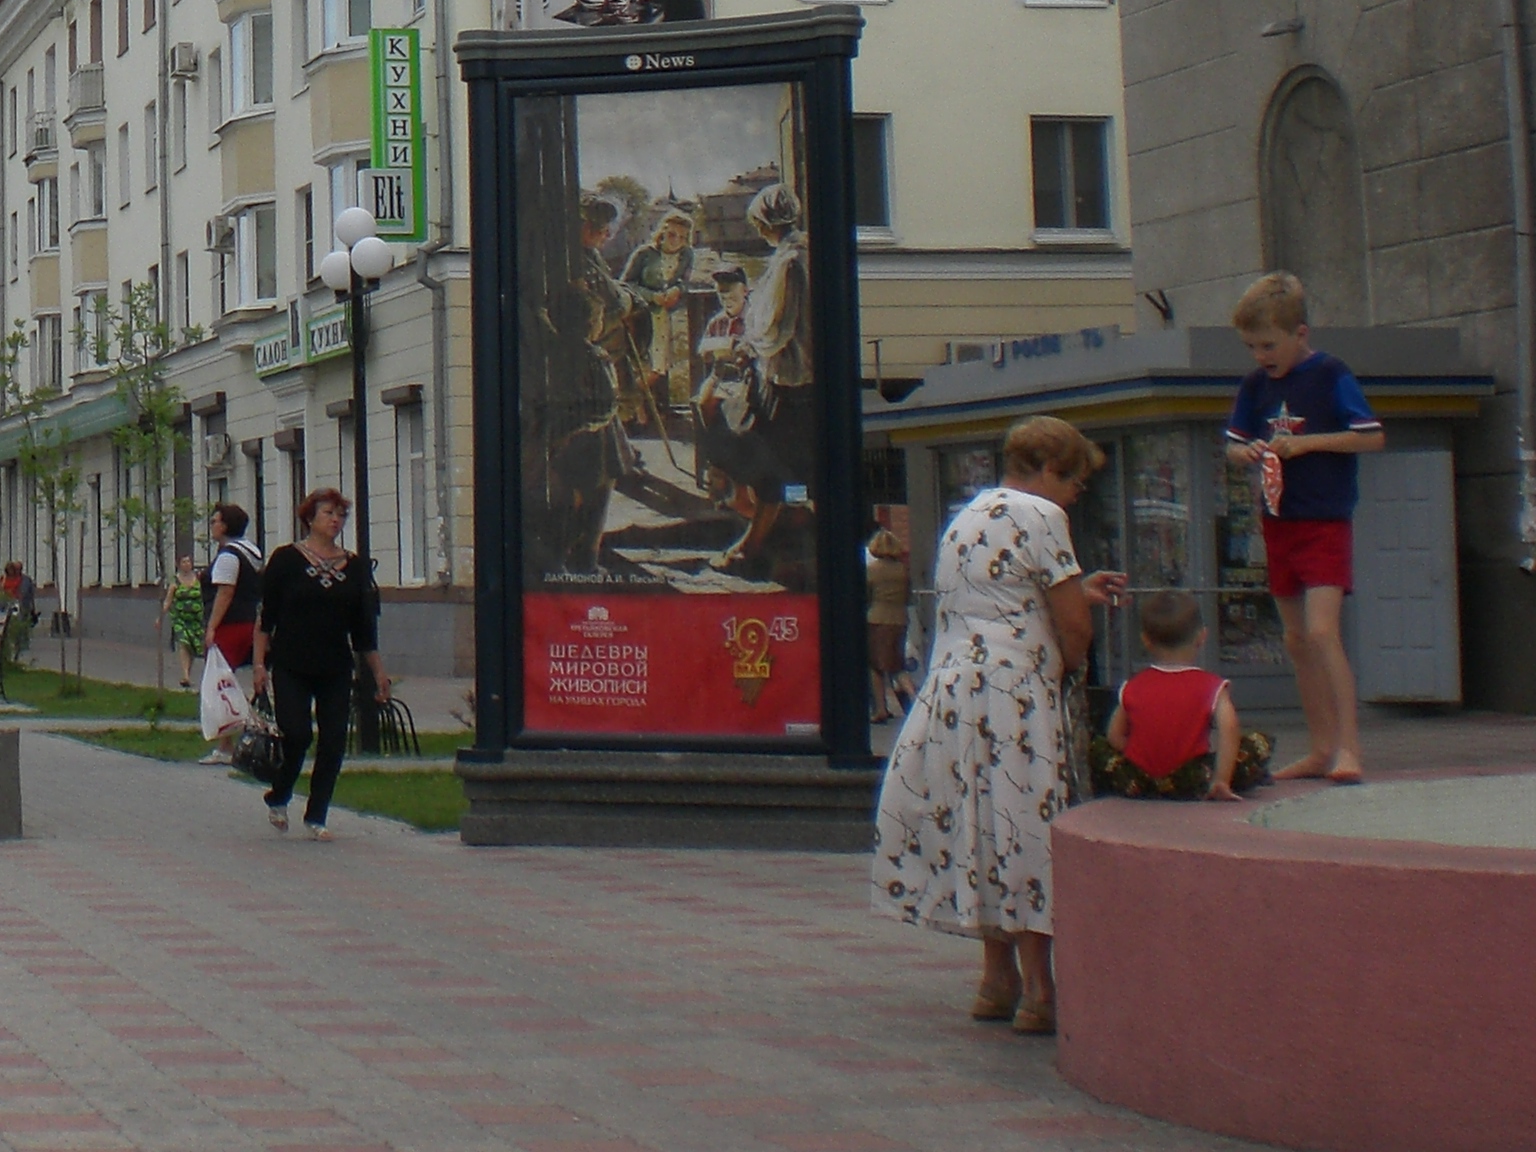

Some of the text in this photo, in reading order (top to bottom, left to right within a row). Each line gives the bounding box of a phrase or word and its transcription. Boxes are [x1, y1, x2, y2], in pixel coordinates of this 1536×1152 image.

[645, 54, 695, 69] News
[388, 38, 409, 163] КУХНИ
[255, 340, 287, 368] САЛОН
[550, 644, 648, 660] ШЕДЕВРЫ
[550, 659, 648, 677] МИРОВОЙ
[549, 677, 648, 694] ЖИВОПИСИ
